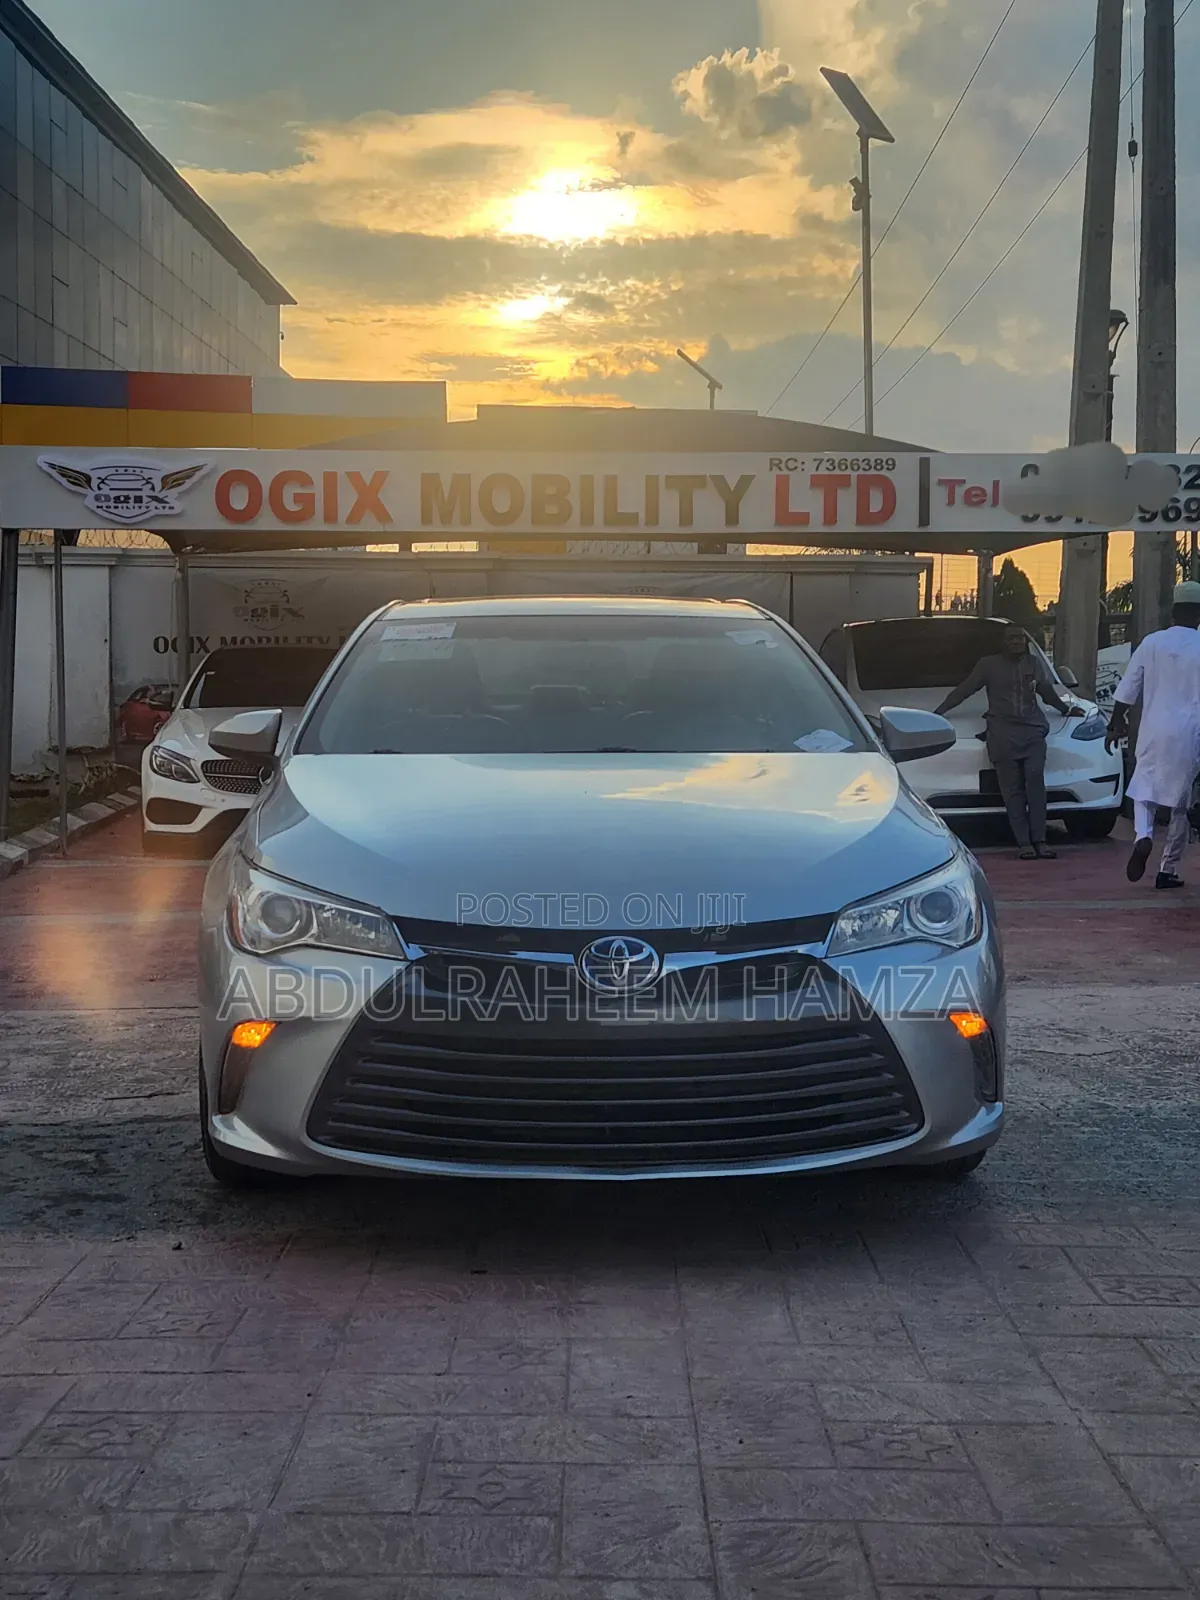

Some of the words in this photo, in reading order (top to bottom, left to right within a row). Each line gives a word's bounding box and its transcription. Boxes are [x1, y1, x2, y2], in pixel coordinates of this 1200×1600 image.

[769, 458, 805, 472] RC:
[812, 457, 896, 472] 7366389
[215, 469, 393, 525] OGIX
[420, 473, 756, 526] MOBILITY
[774, 474, 897, 526] LTD
[937, 478, 1000, 508] Tel
